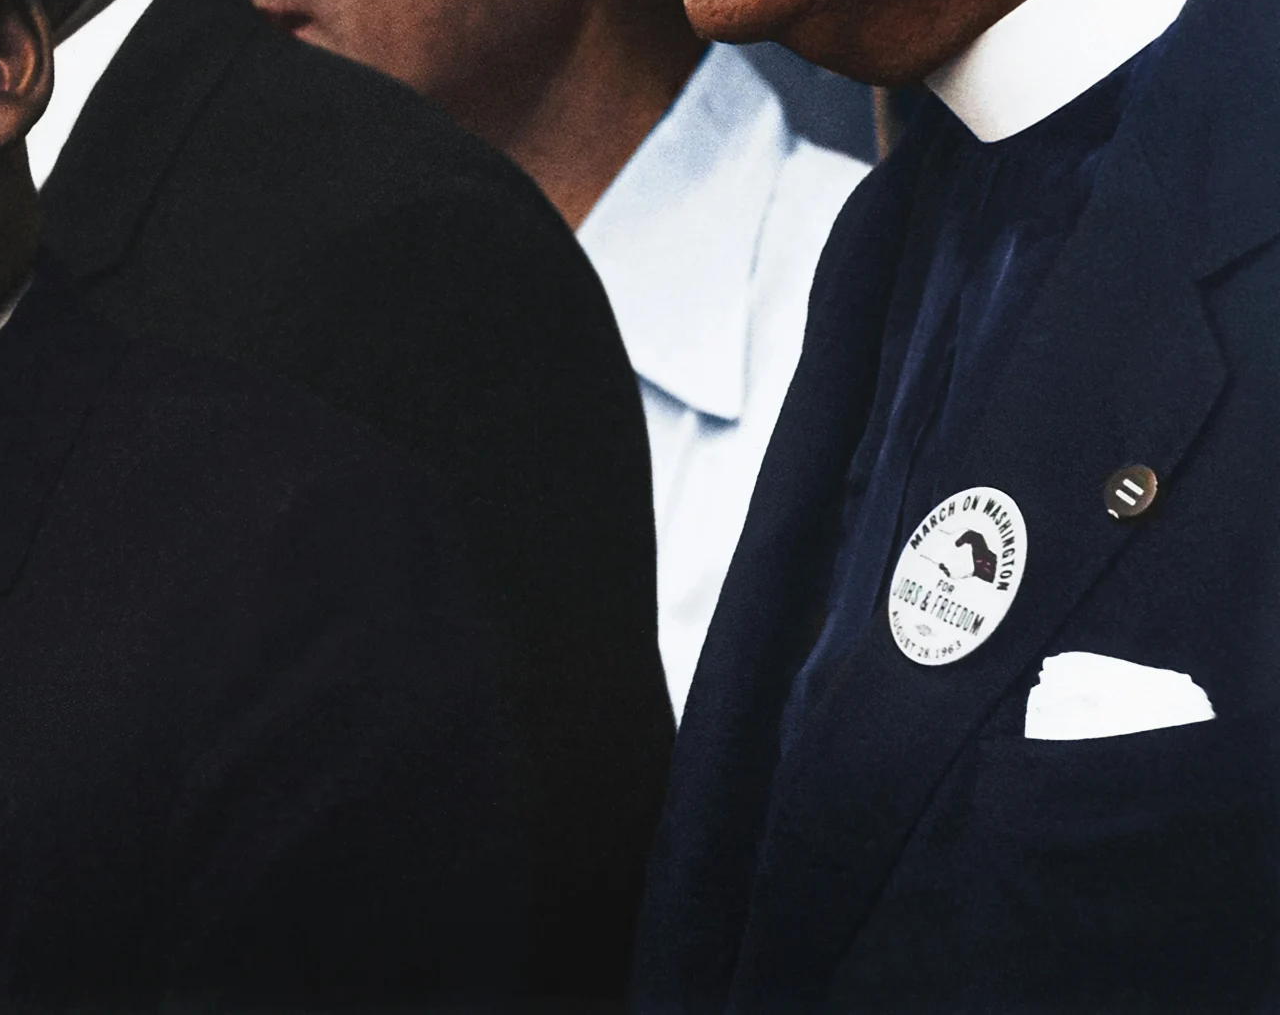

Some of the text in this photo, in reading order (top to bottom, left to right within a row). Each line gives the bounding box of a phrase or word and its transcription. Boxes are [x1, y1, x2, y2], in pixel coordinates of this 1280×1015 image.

[909, 495, 1016, 592] MARCH ON WASHINGTON
[892, 577, 924, 606] JOBS
[919, 590, 932, 612] &
[931, 594, 986, 637] FREEDOM
[936, 579, 956, 595] FOR
[891, 610, 916, 651] AUGUST
